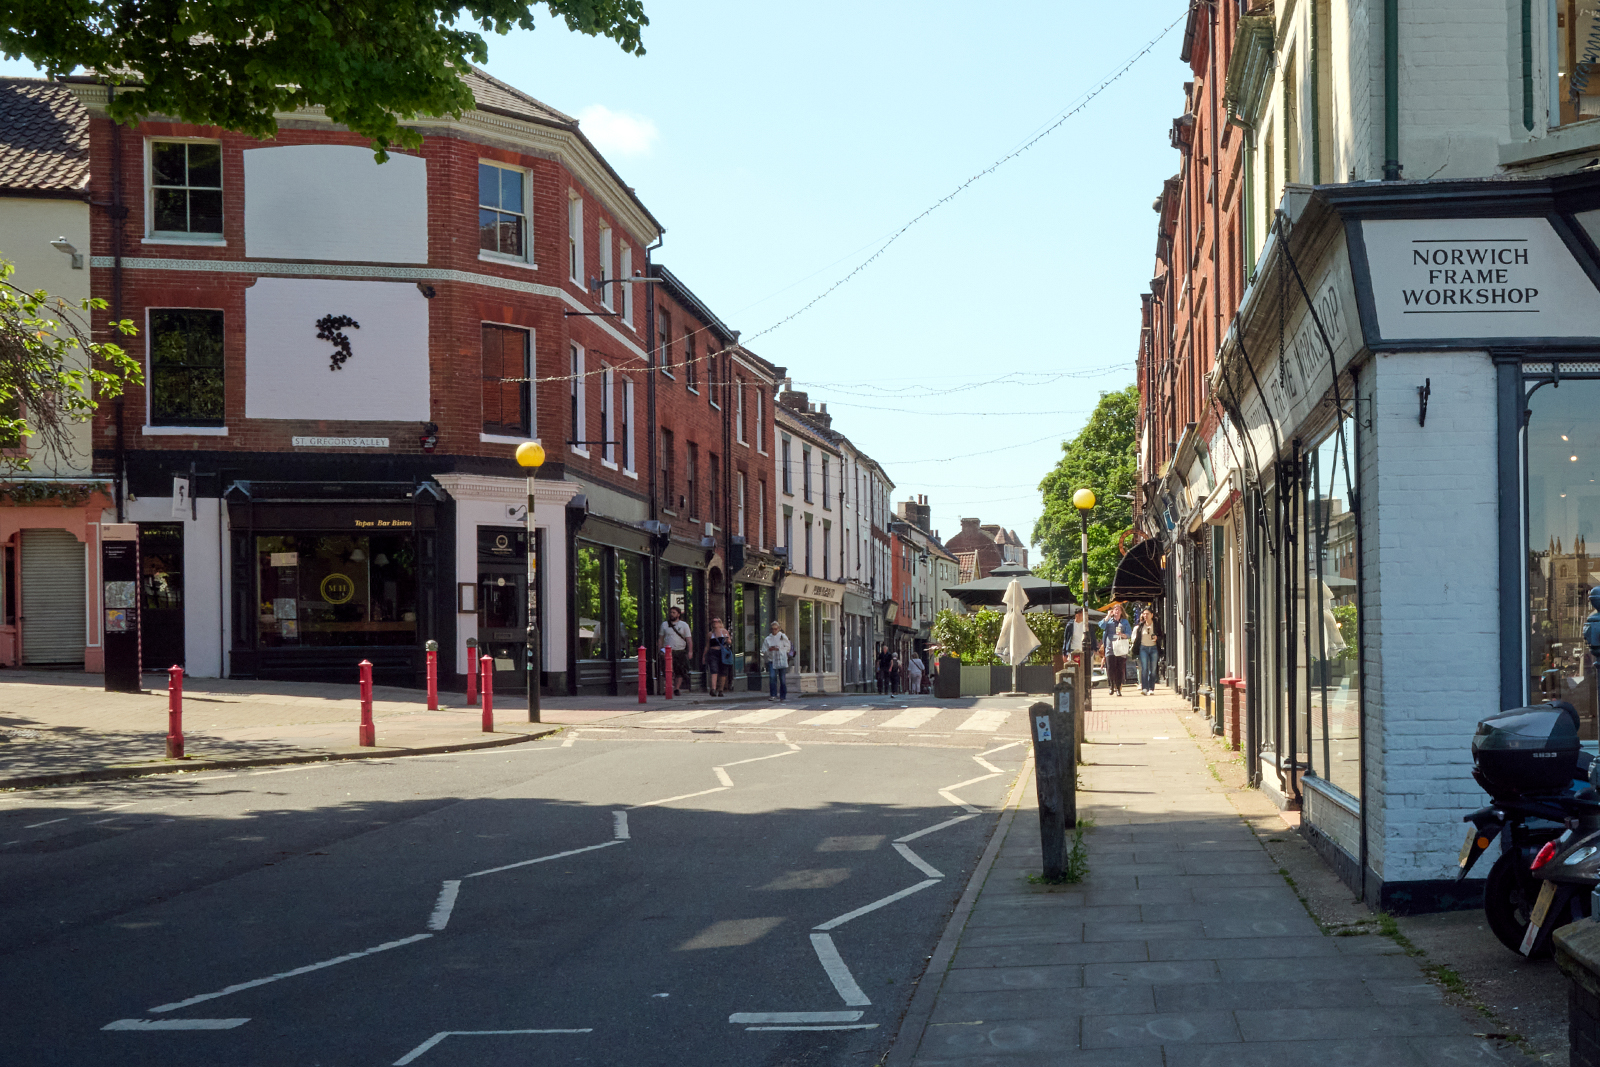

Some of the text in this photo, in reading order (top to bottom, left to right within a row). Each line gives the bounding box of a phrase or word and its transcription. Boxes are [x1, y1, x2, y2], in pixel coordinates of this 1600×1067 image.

[1413, 248, 1529, 266] NORWICH
[1429, 268, 1509, 285] FRAME
[1402, 288, 1540, 306] WORKSHOP
[359, 438, 386, 446] ALLEY
[355, 519, 412, 528] Tapas Bar Bistro
